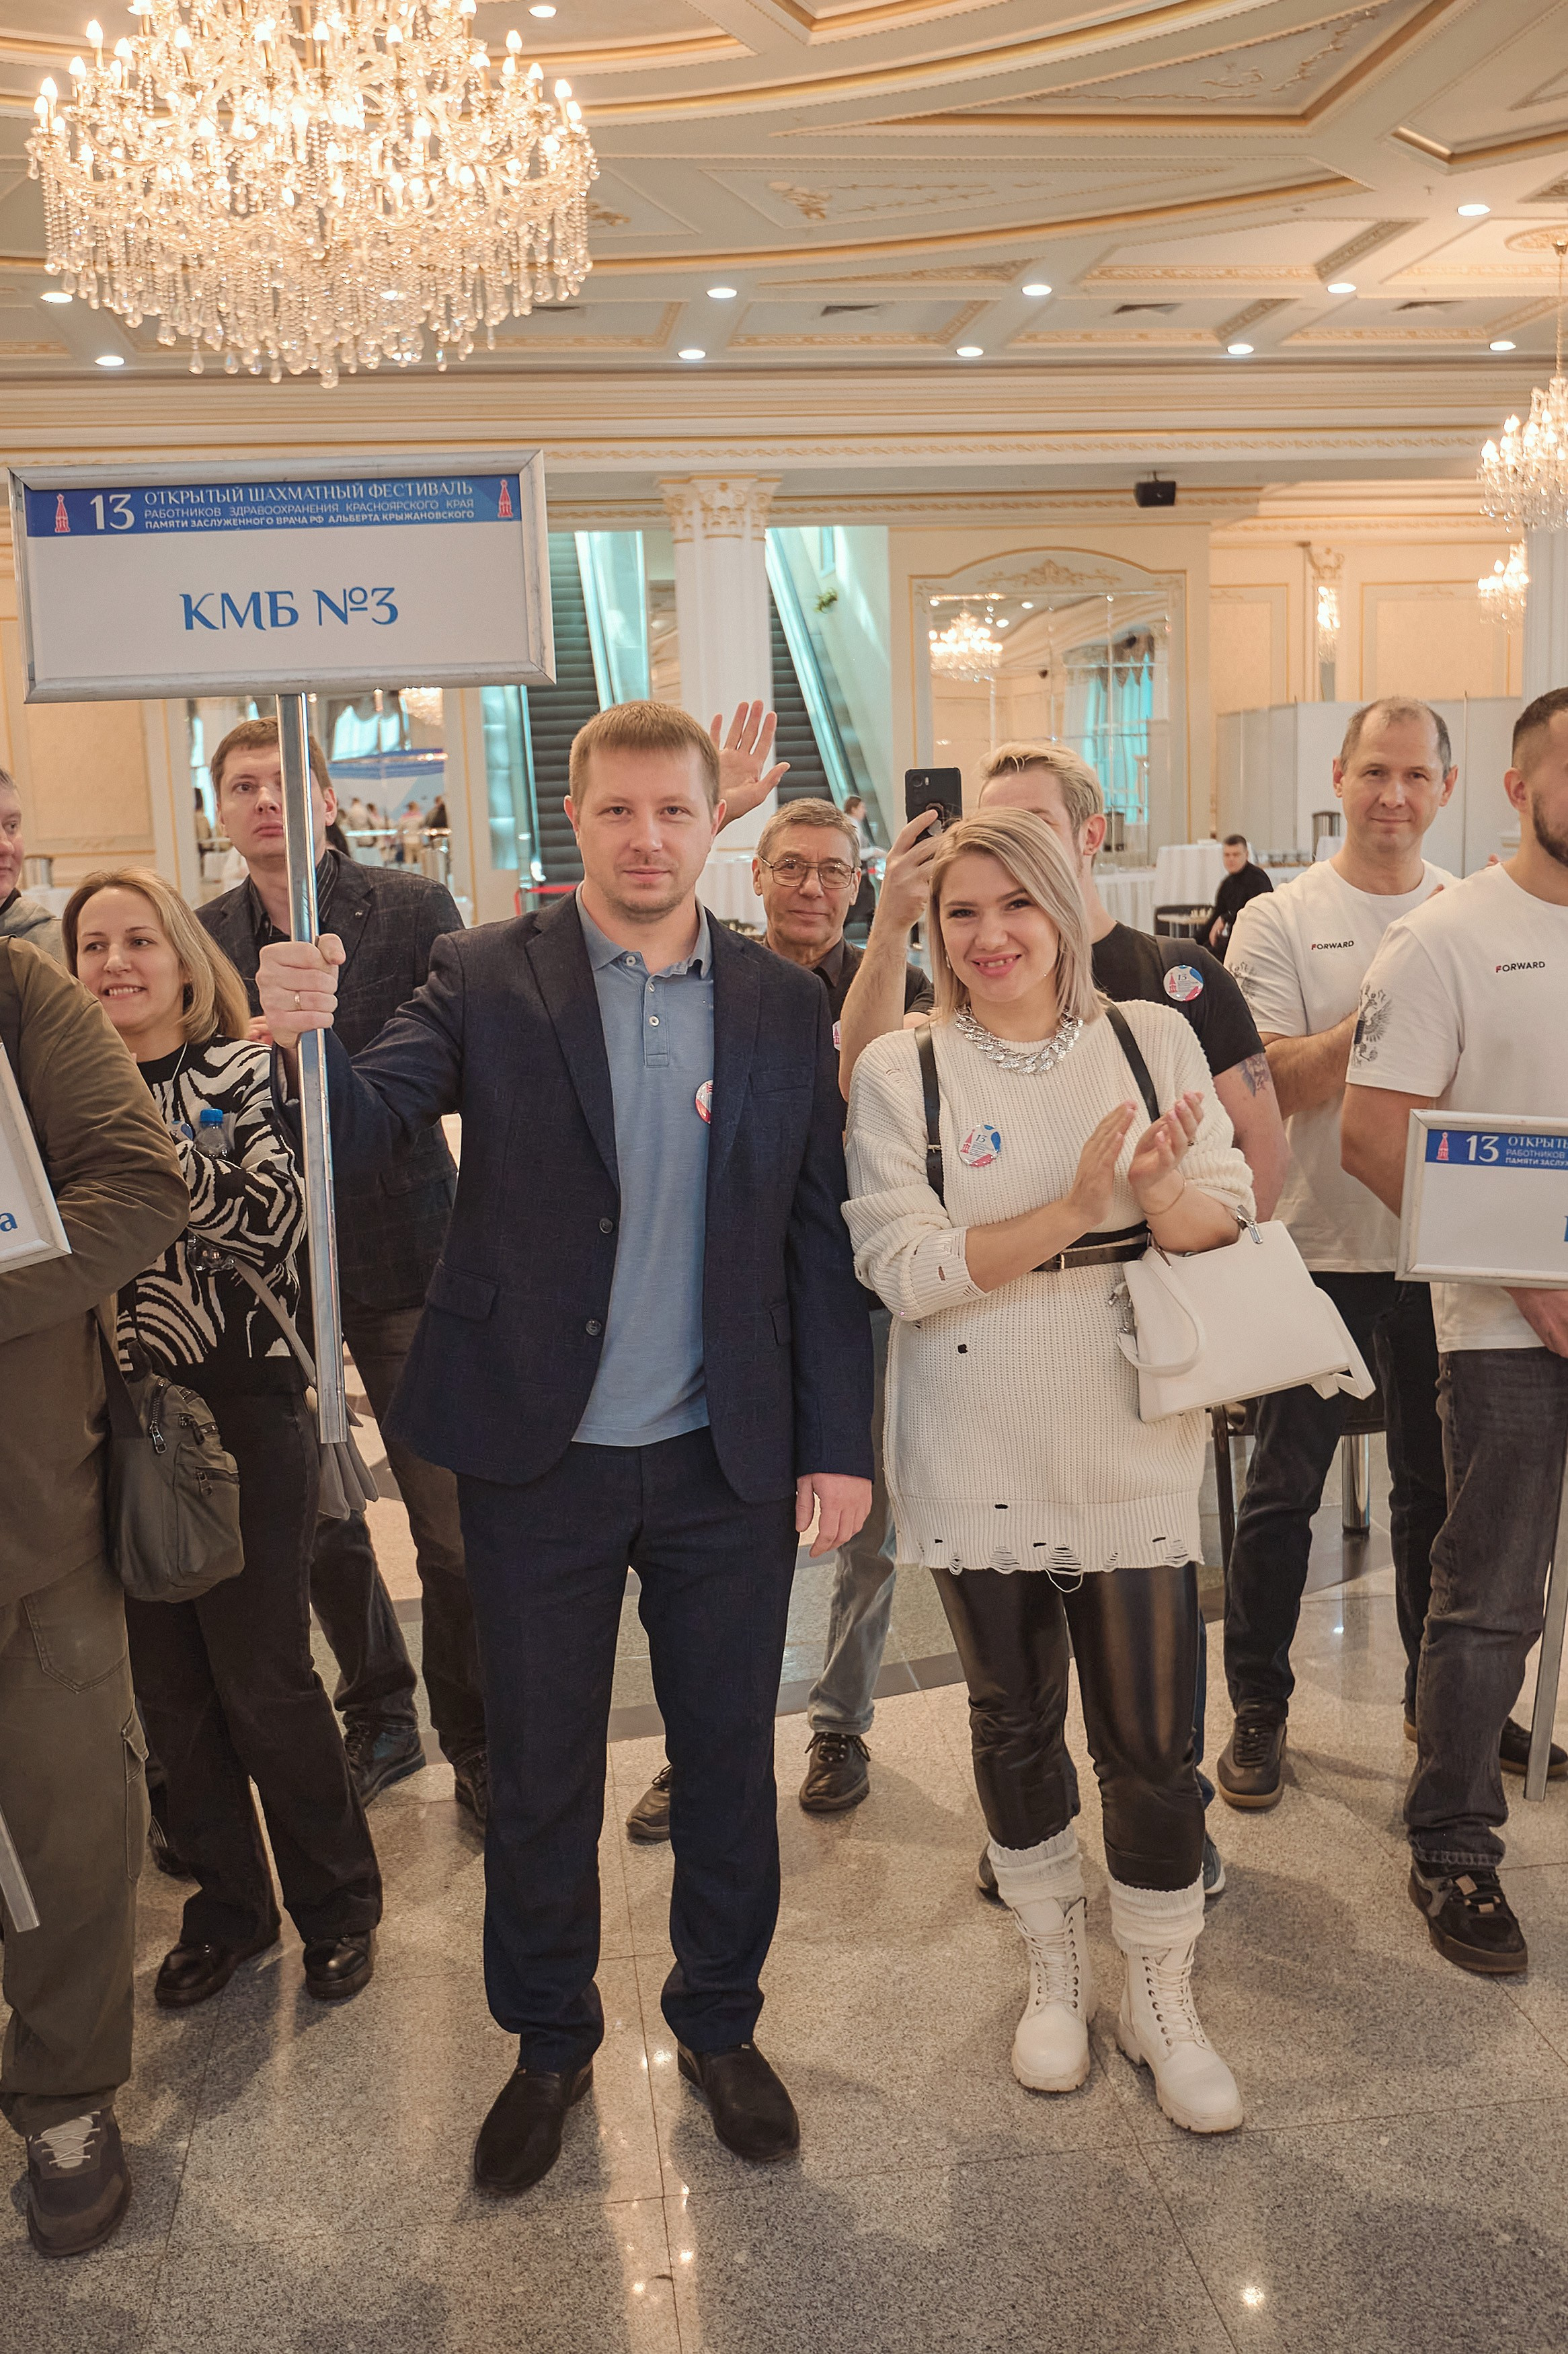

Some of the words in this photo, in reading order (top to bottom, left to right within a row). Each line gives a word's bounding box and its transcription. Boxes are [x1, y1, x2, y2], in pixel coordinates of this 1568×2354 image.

[145, 487, 243, 504] ОТКРЫТЫЙ
[248, 484, 364, 502] ШАХМАТНЫЙ
[368, 482, 473, 498] ФЕСТИВАЛЬ
[90, 494, 135, 530] 13
[144, 508, 222, 519] РАБОТНИКОВ
[229, 503, 339, 517] ЗДРАВООХРАНЕНИЯ
[346, 500, 439, 512] КРАСНОЯРСКОГО
[446, 499, 474, 509] КРАЯ
[145, 519, 188, 529] ПАМЯТИ
[190, 517, 274, 528] ЗАСЛУЖЕННОГО
[276, 515, 309, 525] ВРАЧА
[309, 515, 325, 524] РФ
[328, 513, 380, 523] АЛЬБЕРТА
[382, 510, 475, 521] КРЫЖАНОВСКОГО
[179, 590, 299, 631] КМБ
[312, 586, 399, 625] №3
[1311, 940, 1354, 950] FORWARD
[1495, 961, 1546, 973] FORWARD
[1466, 1135, 1499, 1163] 13
[1506, 1148, 1565, 1160] РАБОТНИКОВ
[1505, 1157, 1539, 1166] ПАМЯТИ
